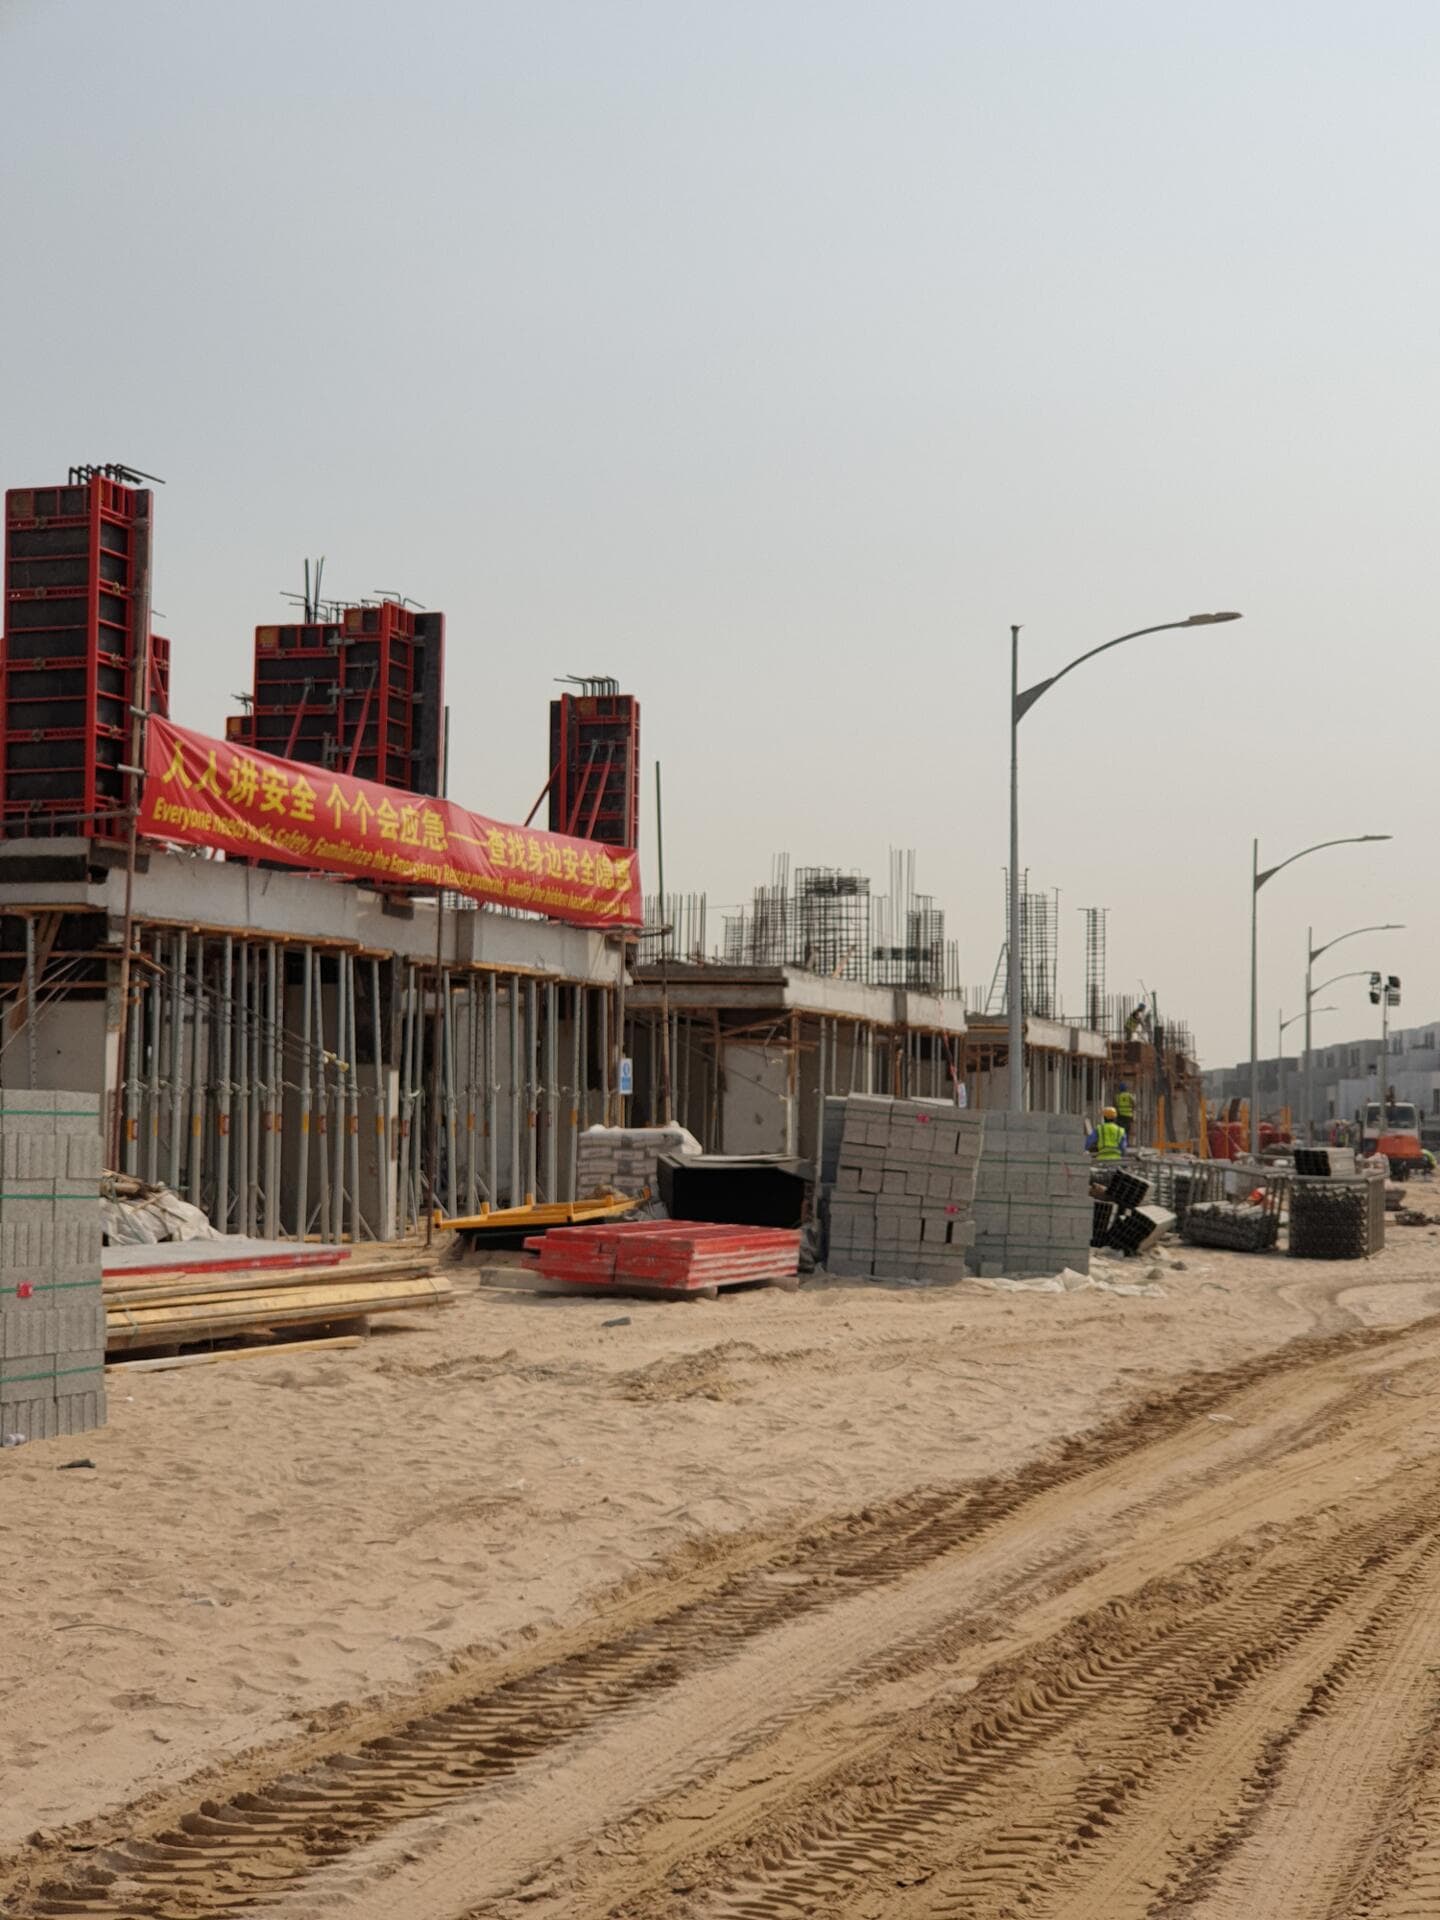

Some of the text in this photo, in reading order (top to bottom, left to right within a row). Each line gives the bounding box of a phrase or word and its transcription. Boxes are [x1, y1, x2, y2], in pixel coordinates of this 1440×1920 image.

[161, 740, 318, 822] 人人讲安全
[152, 797, 212, 832] Everyone
